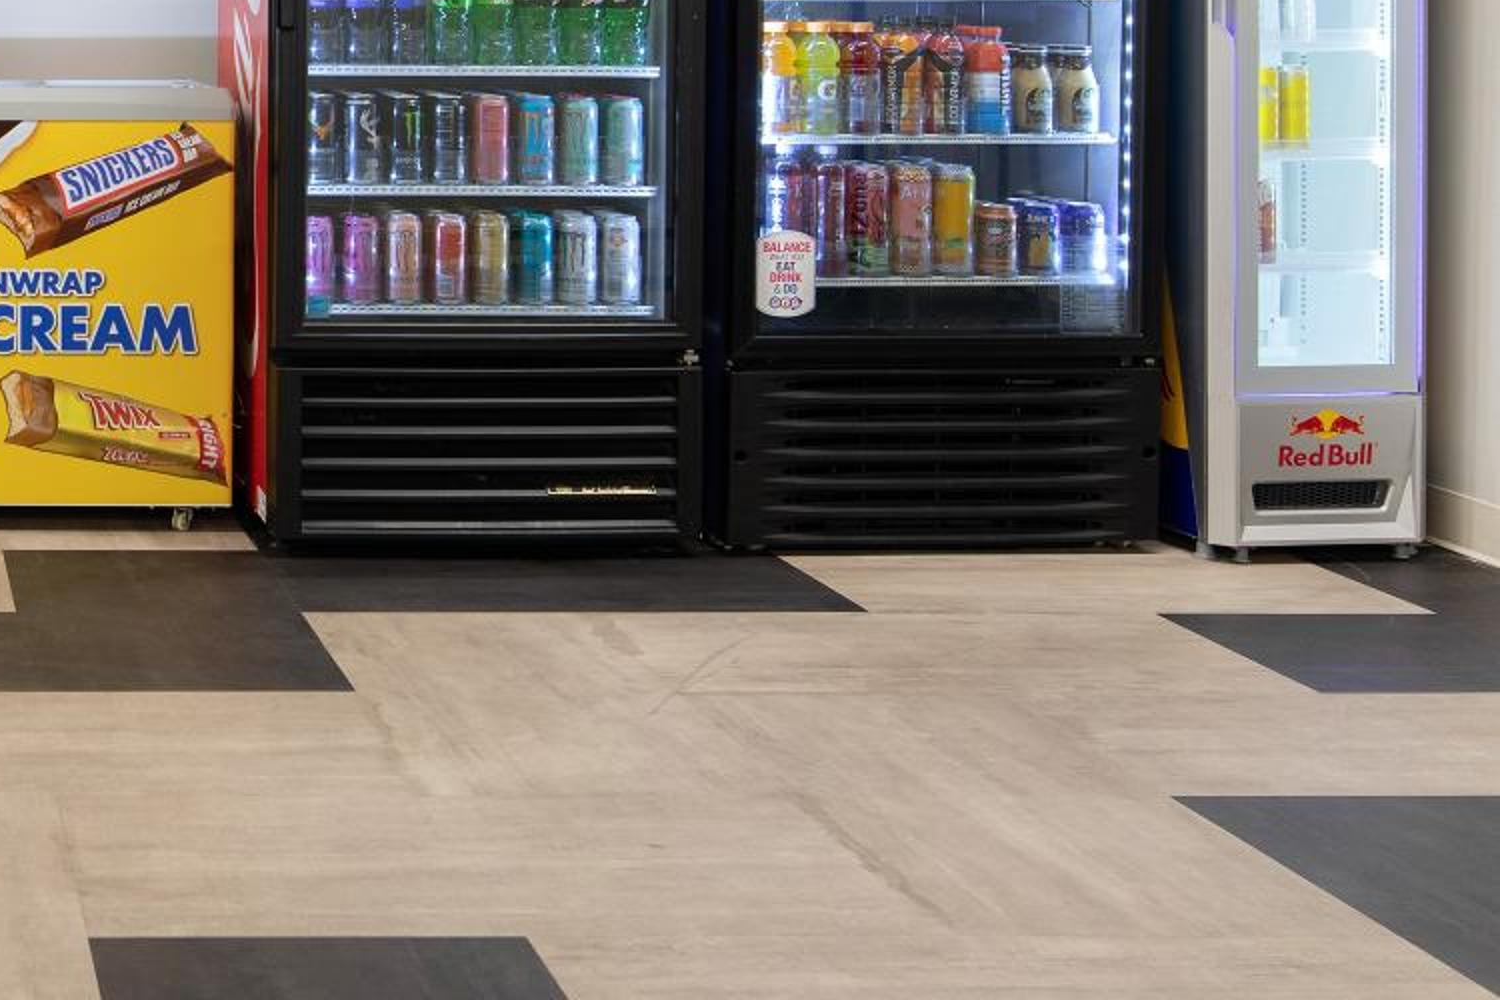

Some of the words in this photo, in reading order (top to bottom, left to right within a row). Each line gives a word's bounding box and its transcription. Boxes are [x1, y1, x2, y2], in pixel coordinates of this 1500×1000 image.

[61, 138, 177, 204] SNICKERS
[763, 241, 812, 253] BALANCE
[776, 261, 796, 271] EAT
[769, 272, 803, 283] DRINK
[79, 391, 161, 430] TWIX
[1278, 443, 1325, 467] Red
[1328, 442, 1373, 467] Bull
